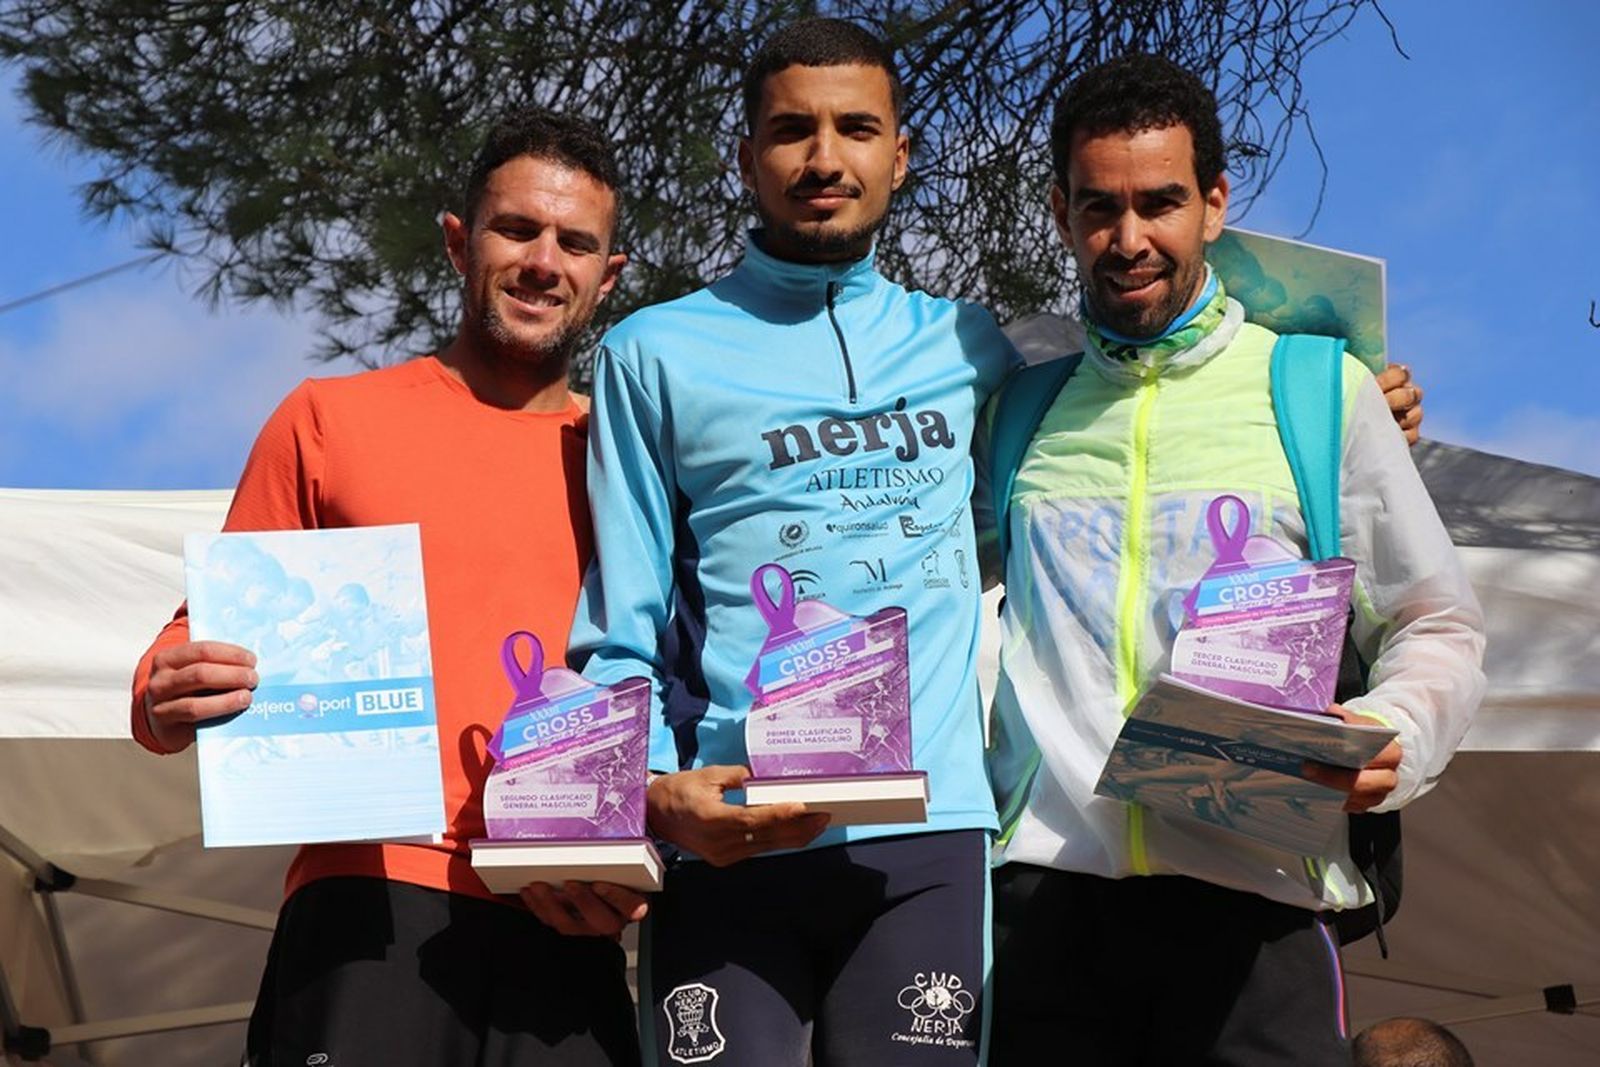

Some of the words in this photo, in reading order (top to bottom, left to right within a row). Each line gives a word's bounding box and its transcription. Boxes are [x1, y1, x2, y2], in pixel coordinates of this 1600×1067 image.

[761, 397, 956, 471] nerja
[805, 467, 945, 492] ATLETISMO
[1218, 580, 1294, 604] CROSS
[779, 640, 851, 676] CROSS
[1191, 658, 1227, 670] GENERAL
[362, 691, 418, 712] BLUE
[522, 707, 594, 742] CROSS
[766, 729, 796, 738] PRIMER
[798, 727, 852, 737] CLASIFICADO
[766, 736, 803, 746] GENERAL
[804, 734, 853, 744] MASCULINO
[500, 794, 538, 802] SEGUNDO
[540, 793, 593, 801] CLASIFICADO
[503, 802, 539, 810] GENERAL
[541, 801, 588, 809] MASCULINO
[914, 971, 963, 990] CMD
[911, 1016, 964, 1037] NERJA
[674, 1041, 720, 1057] ATLETISMO
